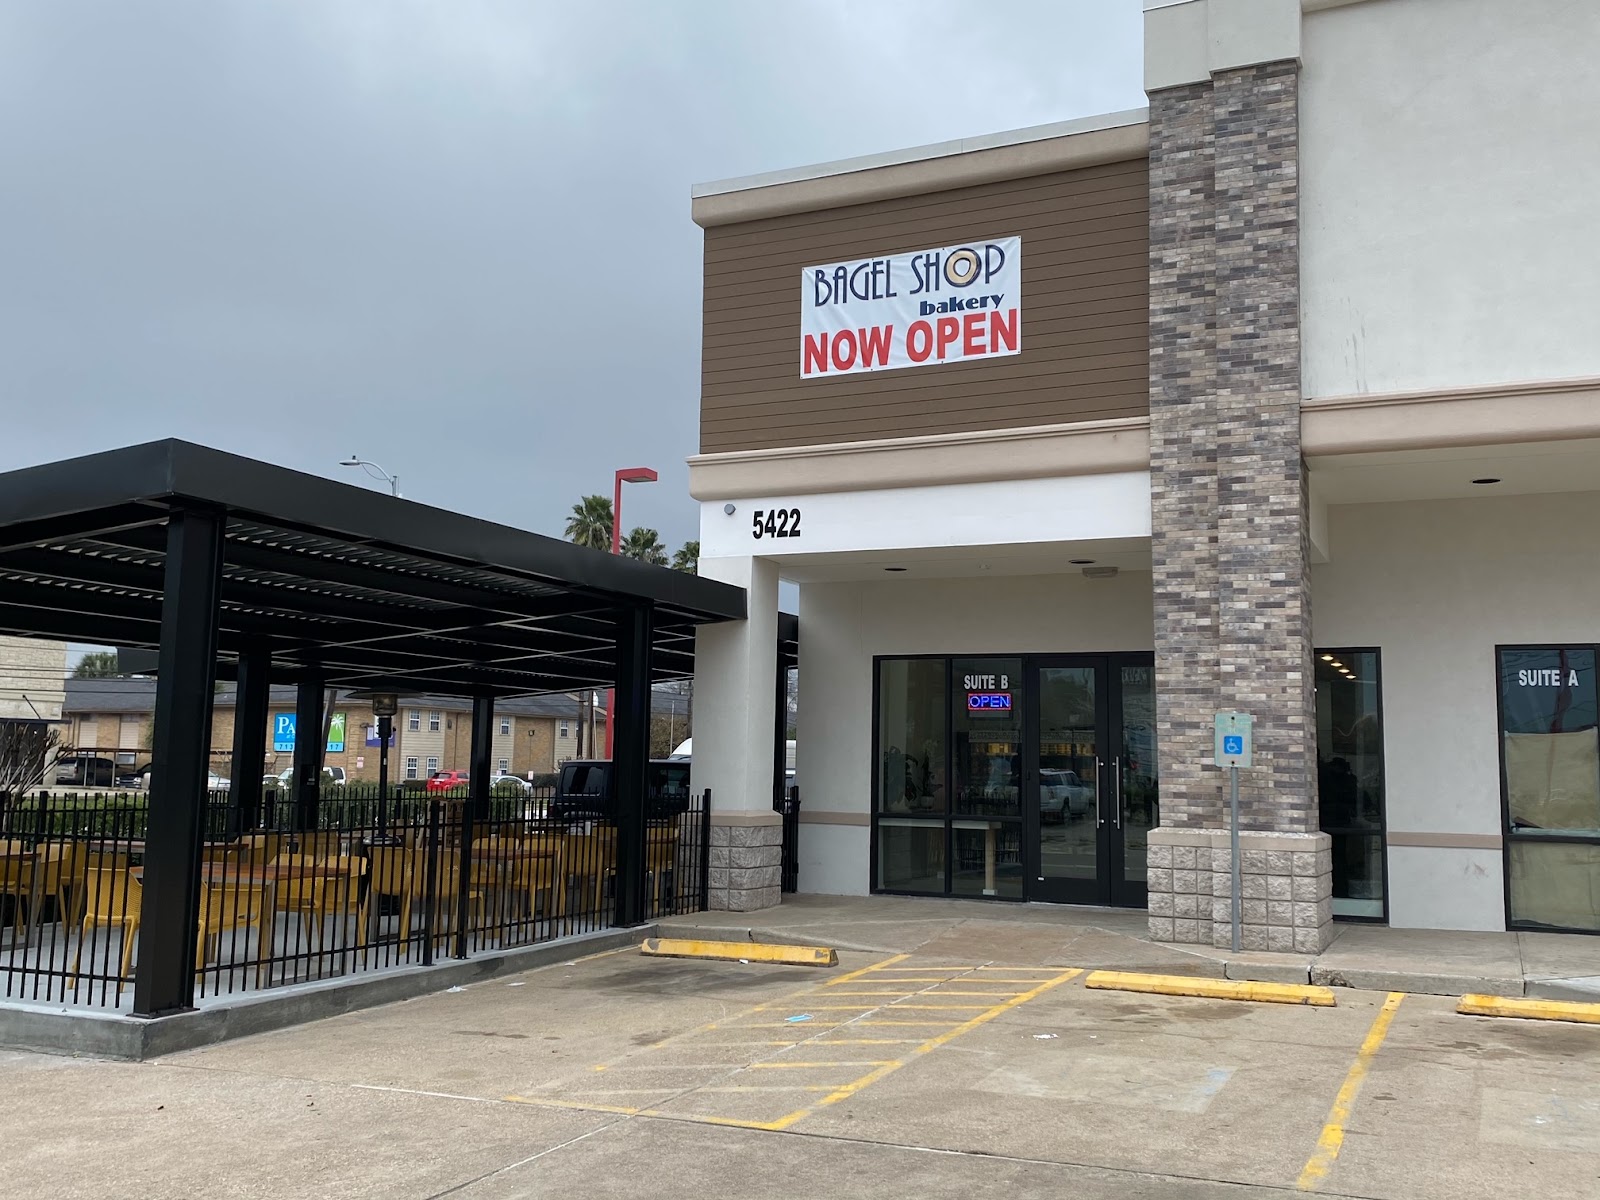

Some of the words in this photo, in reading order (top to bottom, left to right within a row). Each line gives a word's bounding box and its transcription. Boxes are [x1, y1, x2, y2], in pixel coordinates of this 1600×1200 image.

[815, 260, 897, 307] BAGEL
[910, 244, 1005, 295] SHOP
[920, 294, 1004, 316] bakery
[804, 325, 893, 374] NOW
[906, 309, 1017, 362] OPEN
[753, 508, 801, 539] 5422
[964, 675, 995, 689] SUITE
[1001, 675, 1008, 689] B
[1519, 669, 1560, 686] SUITE
[1568, 669, 1579, 686] A
[969, 696, 1009, 708] OPEN
